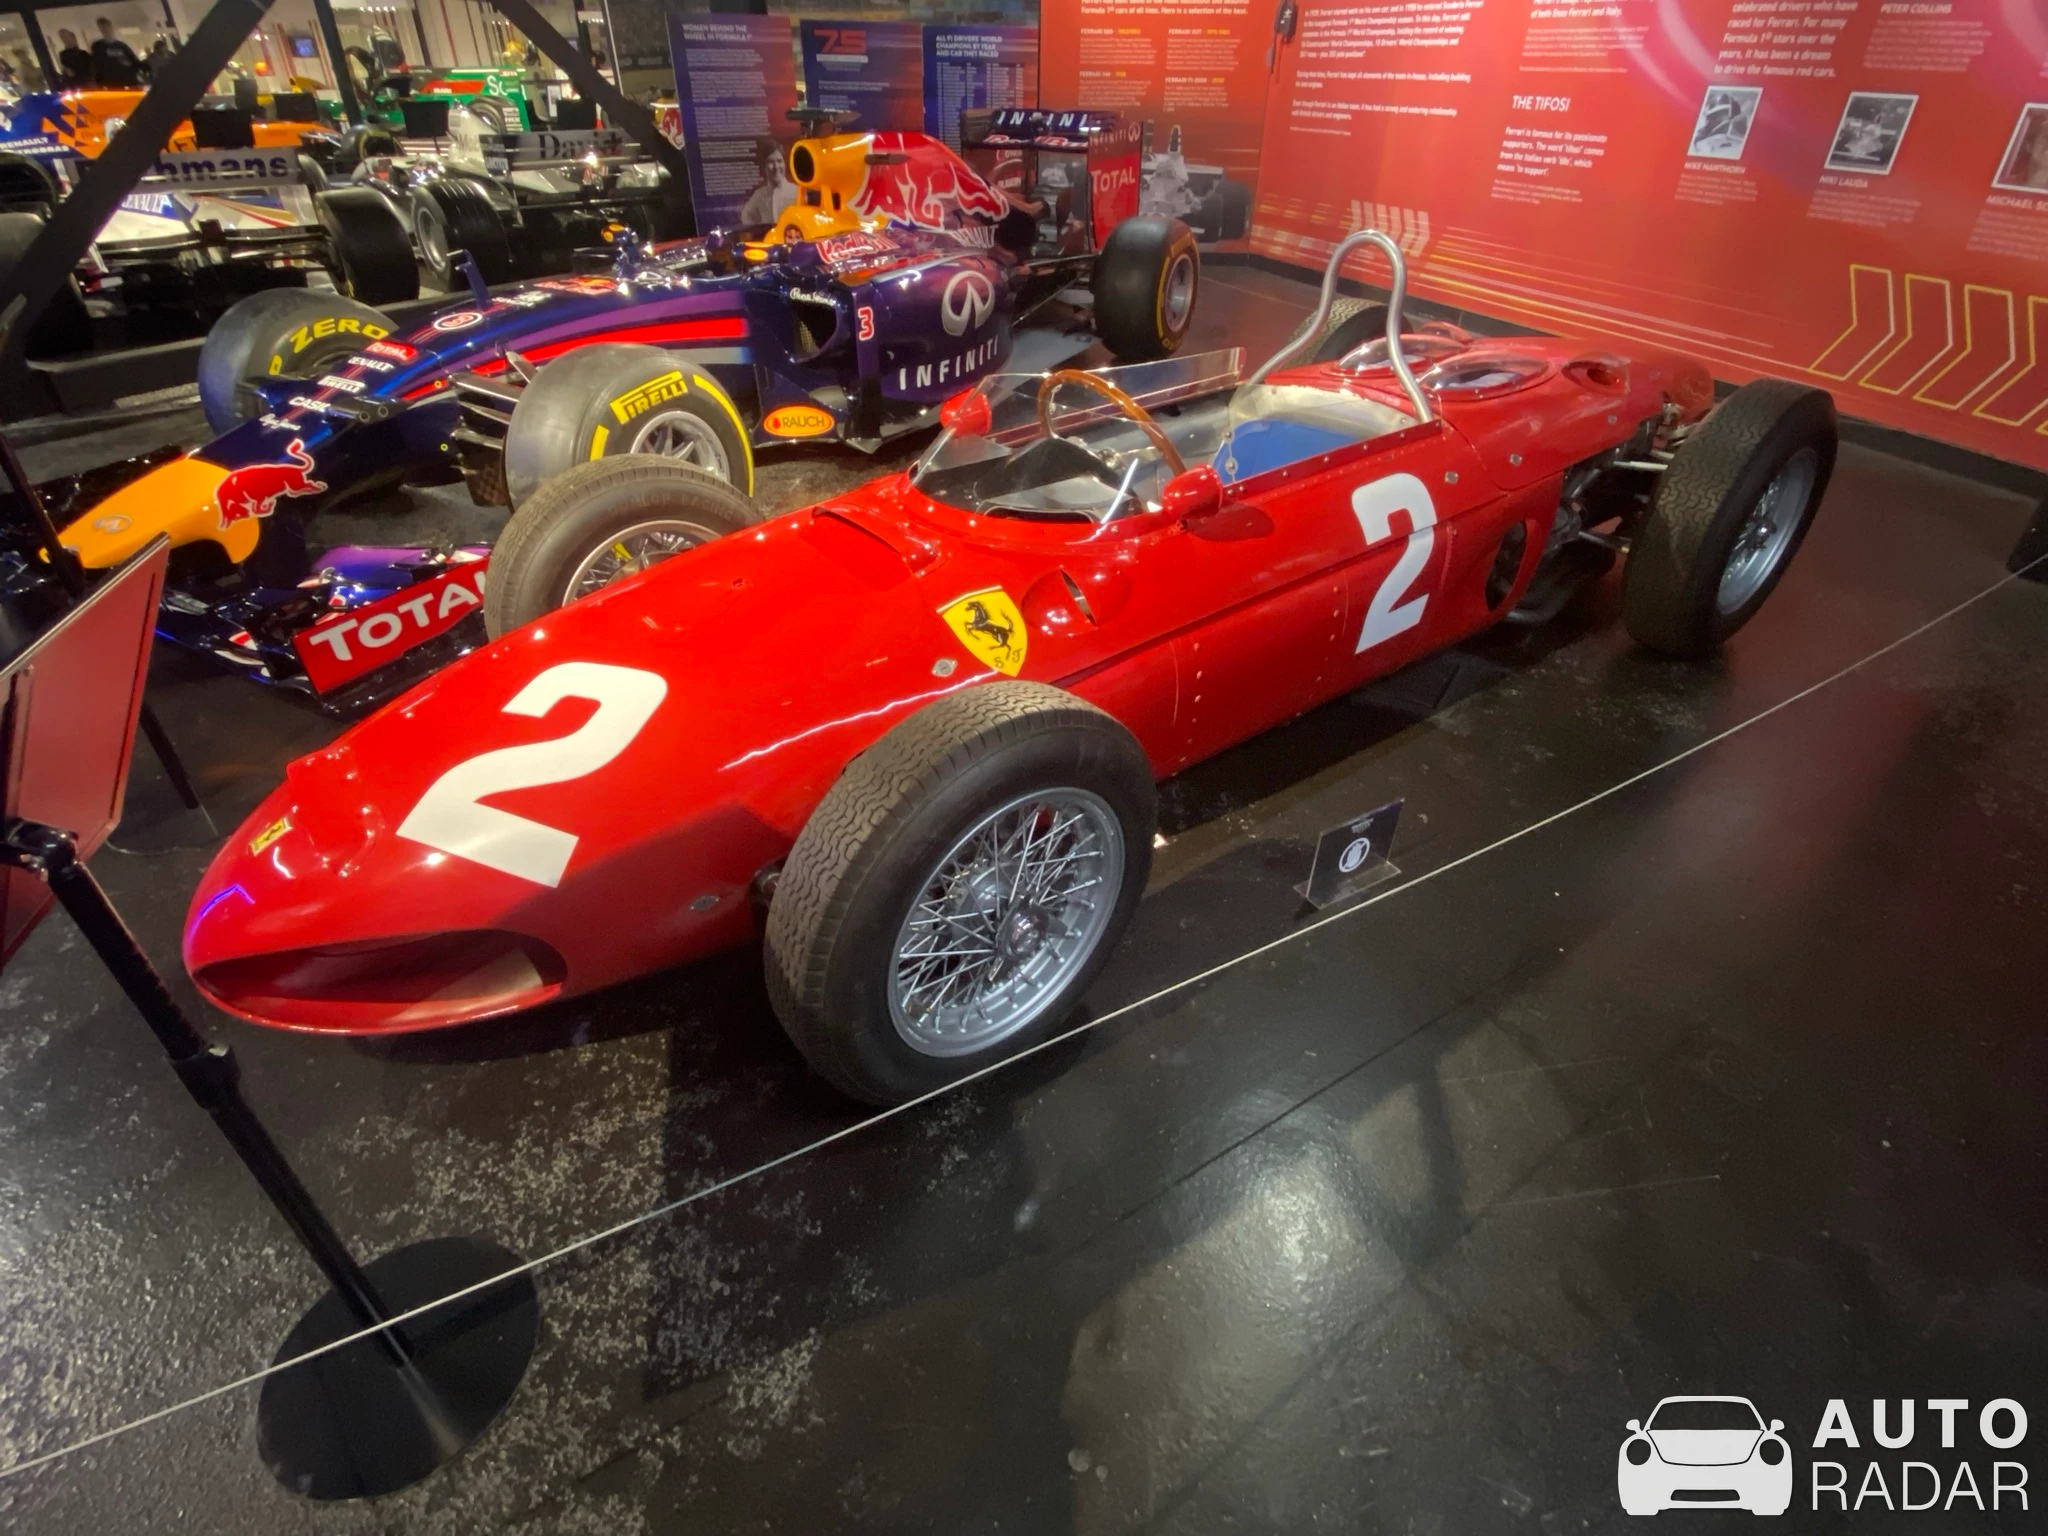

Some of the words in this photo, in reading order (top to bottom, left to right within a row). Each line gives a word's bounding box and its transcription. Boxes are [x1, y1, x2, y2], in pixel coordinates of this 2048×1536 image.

[1569, 7, 1592, 17] Ferrari
[1732, 2, 1777, 12] celebrated
[1778, 1, 1810, 12] drivers
[1813, 1, 1833, 11] who
[1835, 1, 1858, 11] have
[1880, 4, 1909, 13] PETER
[1910, 4, 1952, 14] COLLINS
[1727, 18, 1752, 28] raced
[1753, 17, 1766, 27] for
[1767, 17, 1800, 28] Ferrari.
[1803, 17, 1819, 27] For
[1820, 18, 1847, 30] many
[814, 29, 867, 54] 75
[1723, 33, 1758, 44] Formula
[1773, 34, 1795, 44] stars
[1797, 35, 1818, 44] over
[1820, 34, 1836, 44] the
[1718, 50, 1743, 61] years,
[1745, 49, 1753, 59] it
[1754, 50, 1769, 59] has
[1770, 50, 1792, 59] been
[1793, 51, 1799, 59] a
[1801, 50, 1832, 60] dream
[1714, 64, 1723, 73] to
[1724, 64, 1745, 74] drive
[1747, 65, 1761, 74] the
[1762, 64, 1794, 75] famous
[1796, 65, 1813, 75] red
[1512, 95, 1533, 110] THE
[1535, 96, 1571, 112] TIFOSI
[1505, 126, 1525, 136] Ferrari
[1090, 166, 1136, 194] TOTAL
[857, 305, 874, 341] 3
[289, 317, 389, 354] ZERO
[899, 334, 999, 391] INFINITI
[610, 370, 688, 425] PIRELLI
[782, 410, 825, 429] RAUCH
[1351, 472, 1437, 655] 2
[396, 661, 668, 888] 2
